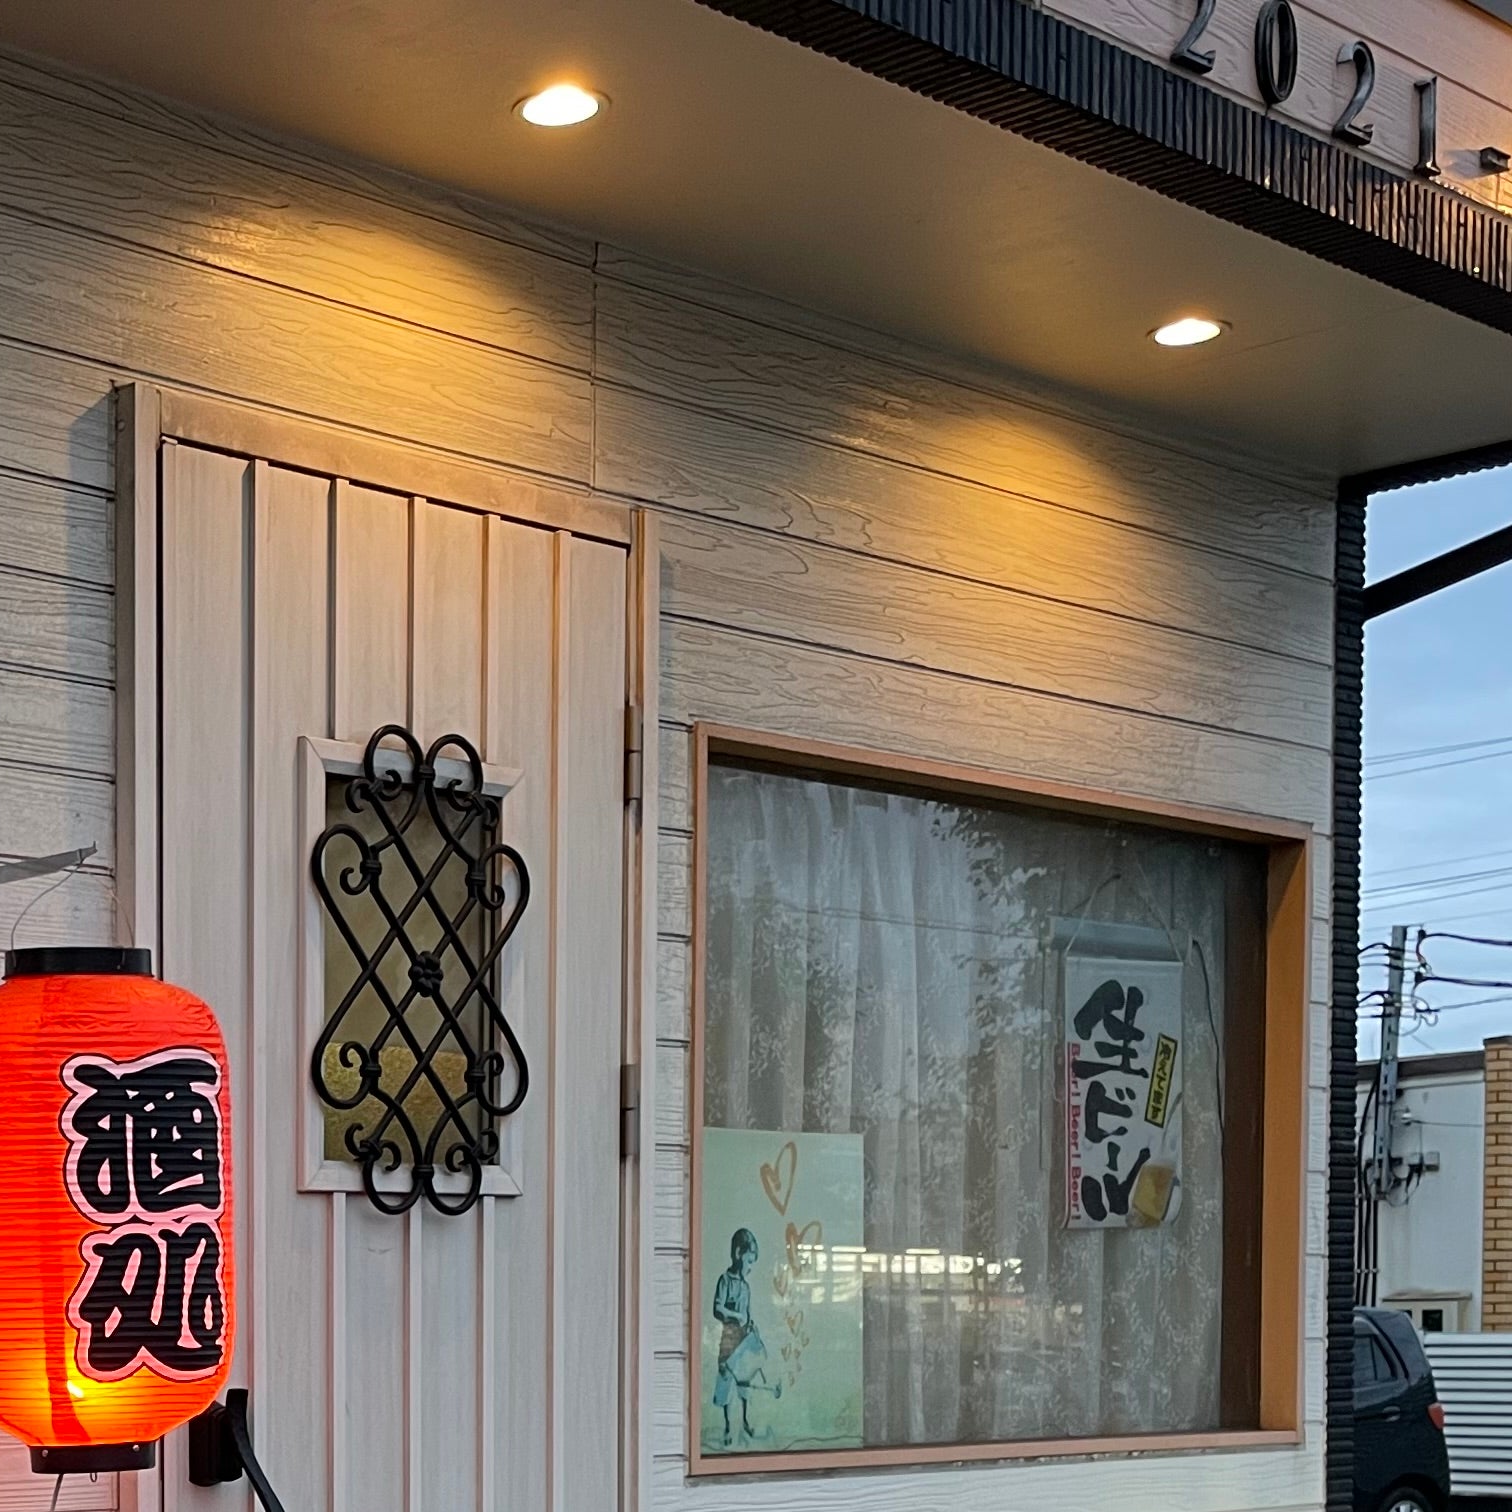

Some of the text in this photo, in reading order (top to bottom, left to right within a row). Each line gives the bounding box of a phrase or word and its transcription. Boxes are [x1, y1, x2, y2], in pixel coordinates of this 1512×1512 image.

[1170, 0, 1441, 175] 2021
[1070, 1043, 1082, 1220] Br! Beer! Beer!
[1073, 979, 1149, 1222] 生ビール
